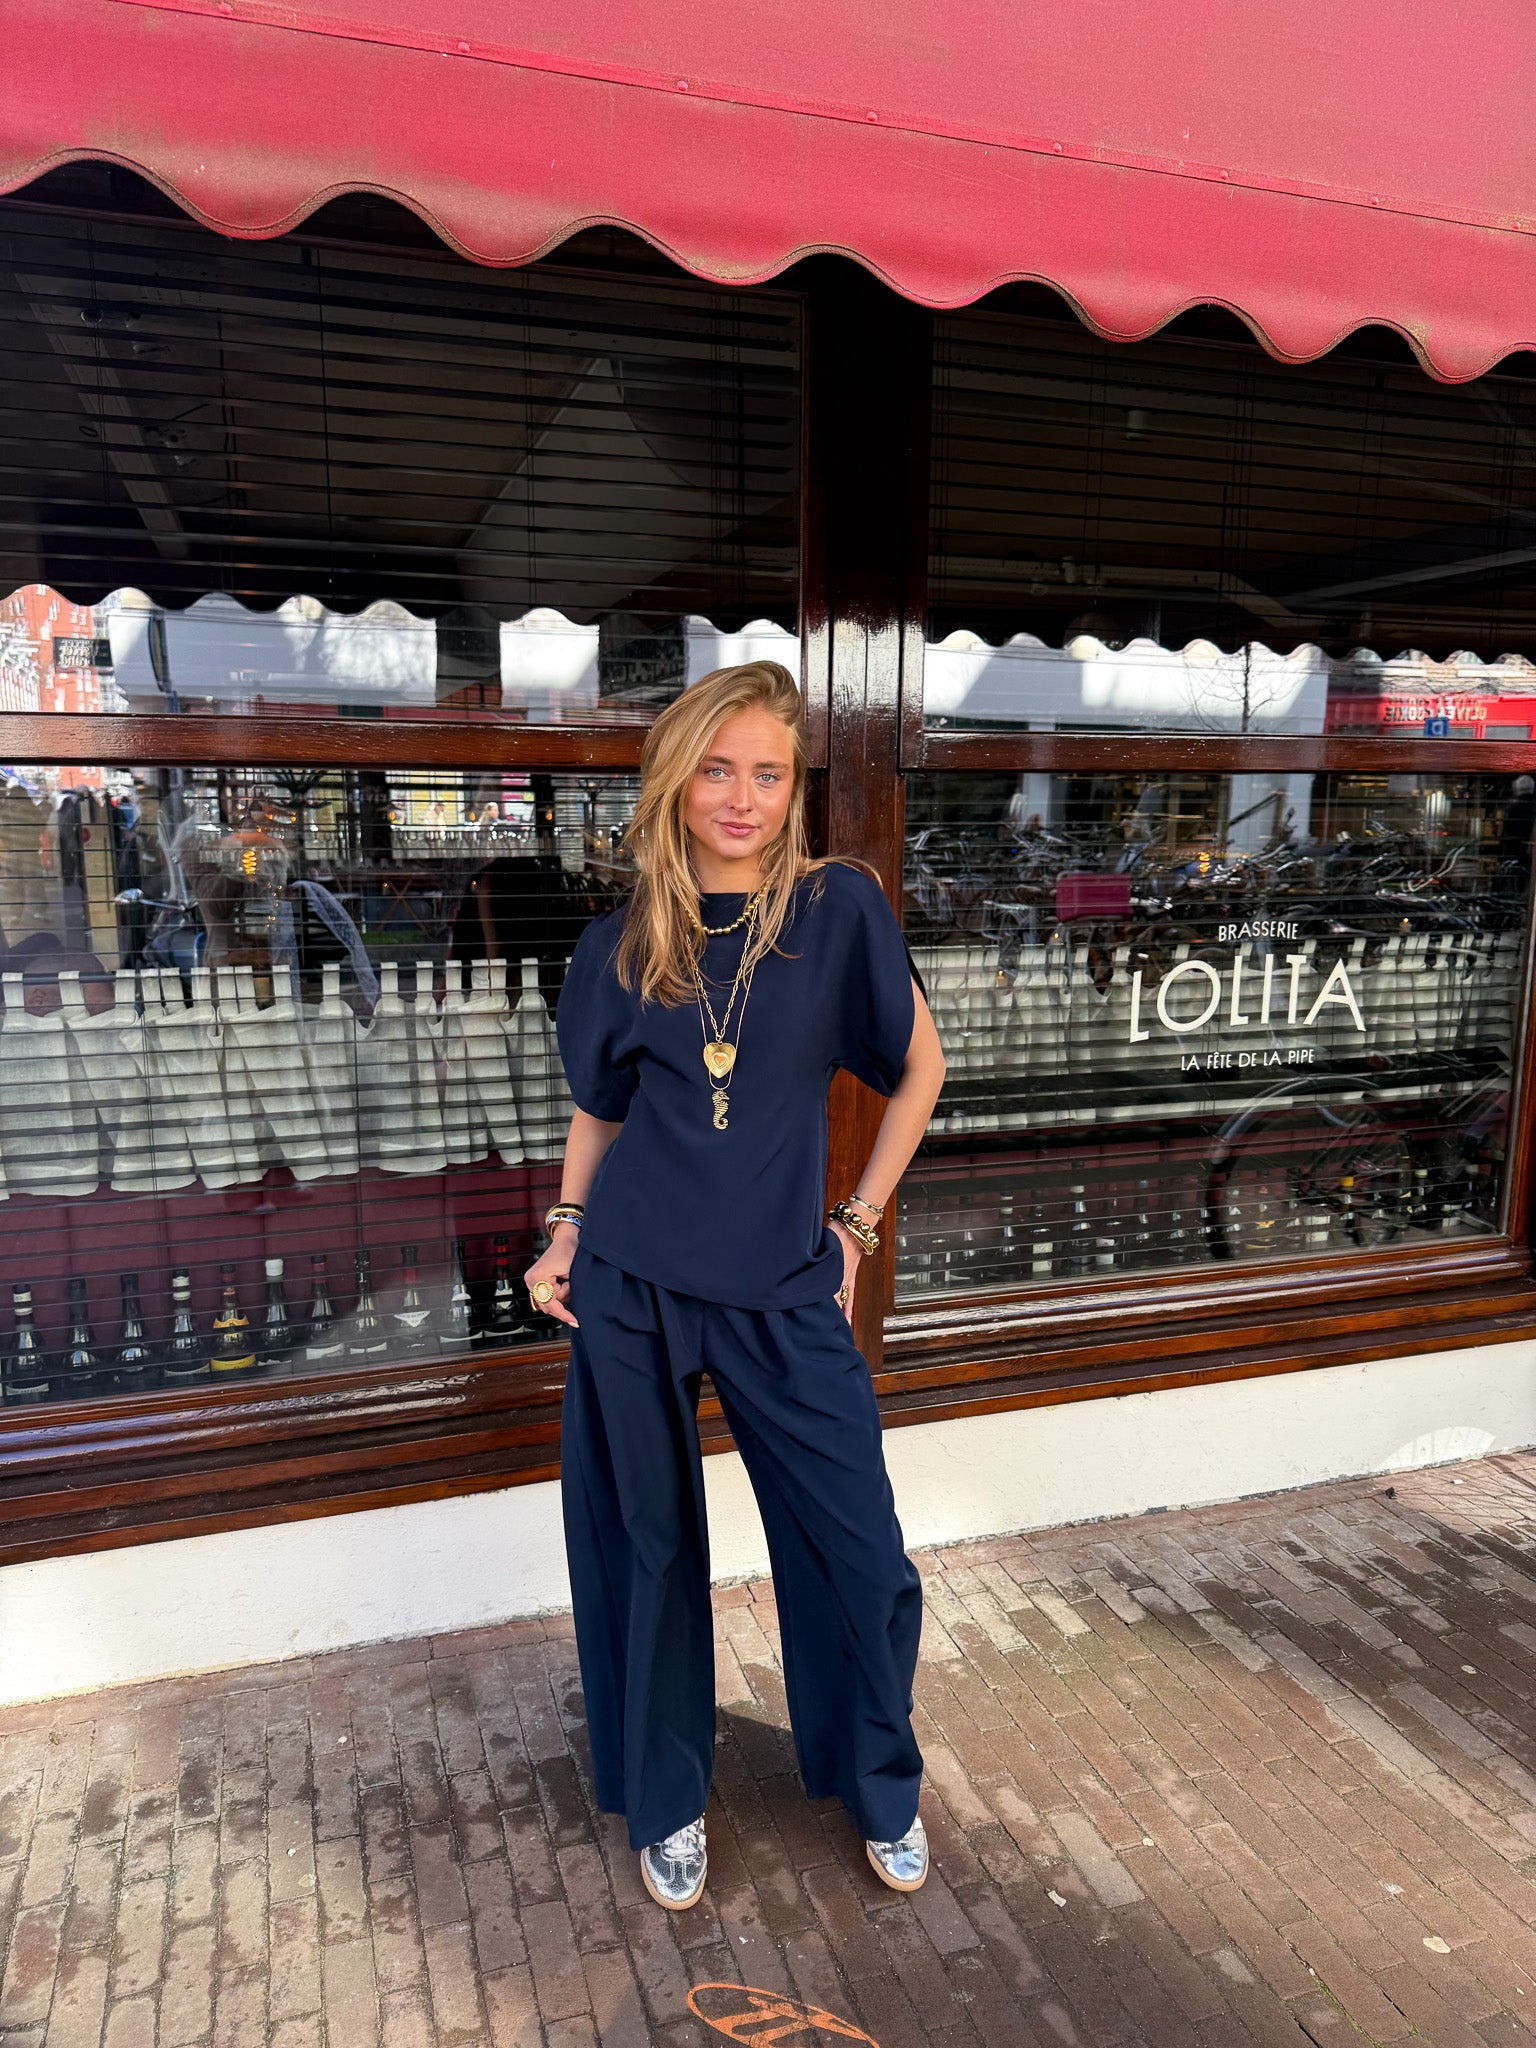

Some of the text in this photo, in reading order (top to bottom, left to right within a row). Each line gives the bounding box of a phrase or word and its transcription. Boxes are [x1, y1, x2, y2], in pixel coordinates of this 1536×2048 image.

[1218, 921, 1299, 942] BRASSERIE
[1130, 954, 1367, 1043] LOLITA
[1181, 1049, 1315, 1071] LA FÊTE DE LA PIPE
